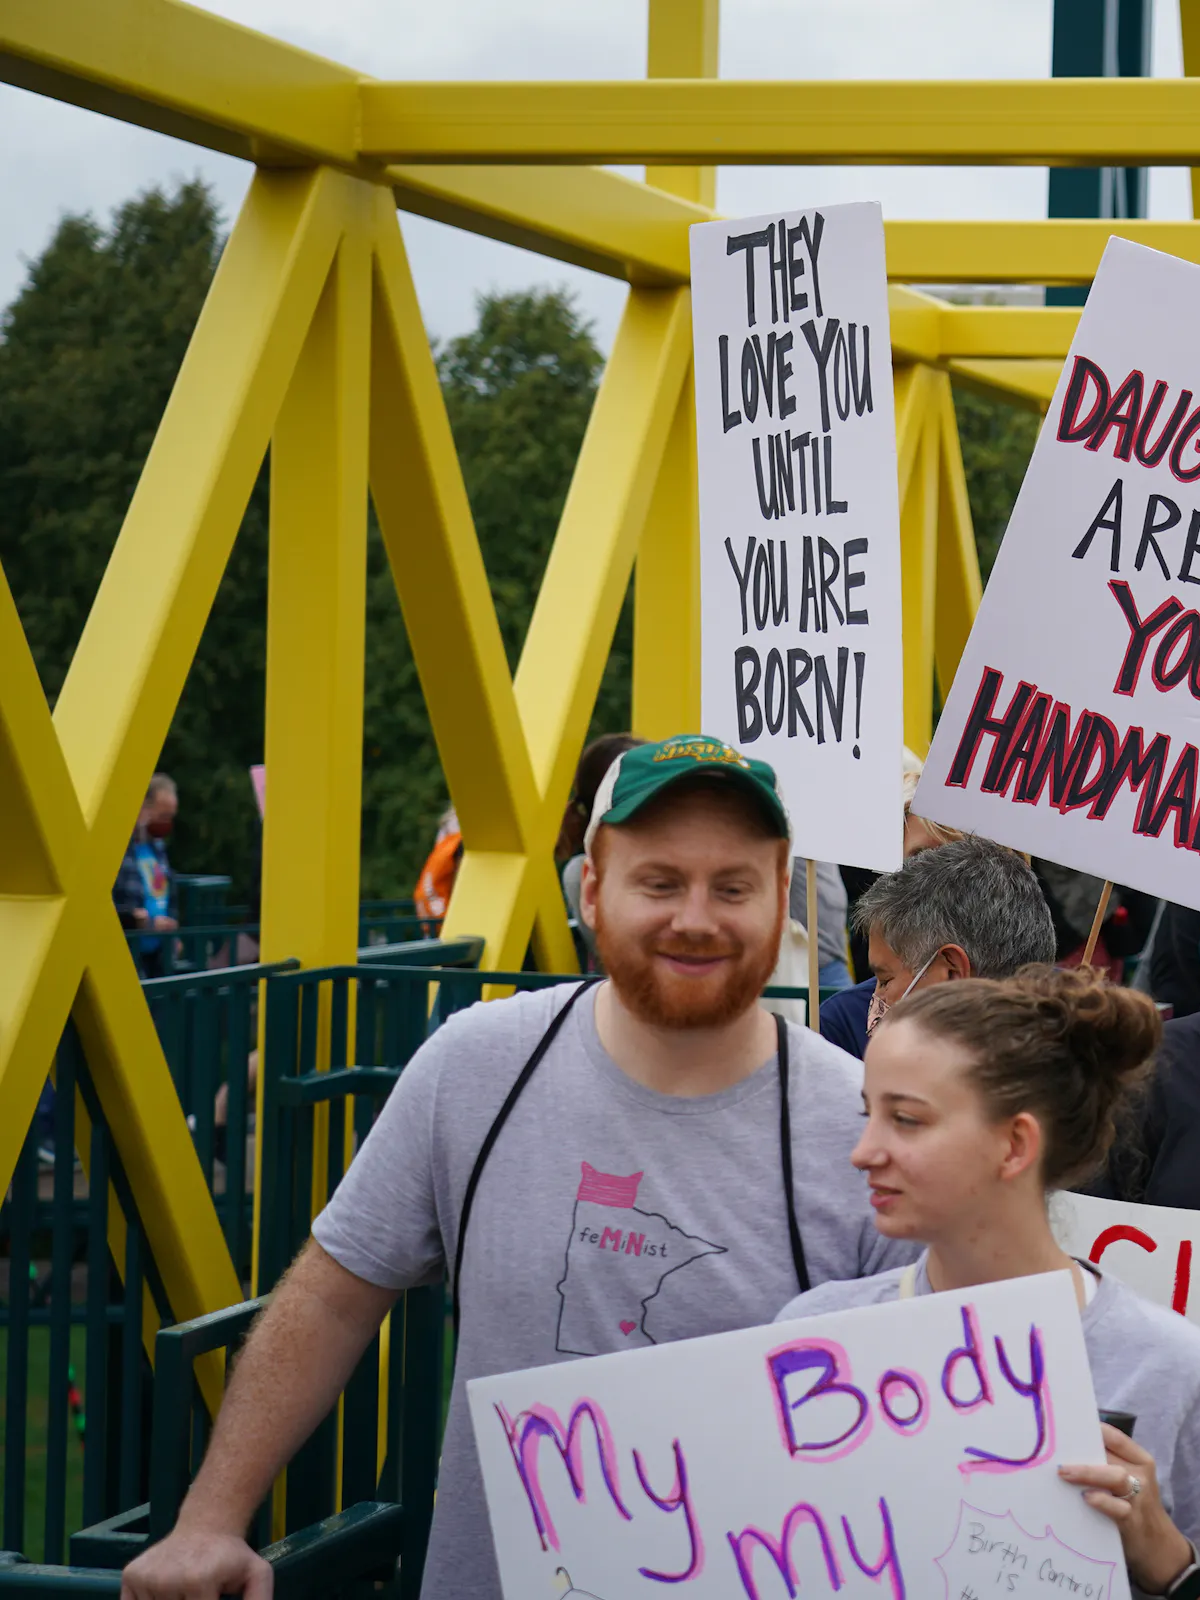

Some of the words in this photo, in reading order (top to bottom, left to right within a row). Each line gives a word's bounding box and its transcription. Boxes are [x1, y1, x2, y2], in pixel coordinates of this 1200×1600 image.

[726, 211, 826, 328] THEY
[718, 330, 799, 433] LOVE
[800, 318, 875, 433] YOU
[752, 429, 849, 520] UNTIL
[724, 535, 789, 635] YOU
[798, 535, 870, 633] ARE
[733, 645, 867, 760] BORN!
[766, 1304, 1056, 1480] Body
[967, 1521, 1029, 1570] Birth
[1038, 1557, 1104, 1600] Control
[995, 1565, 1020, 1592] is
